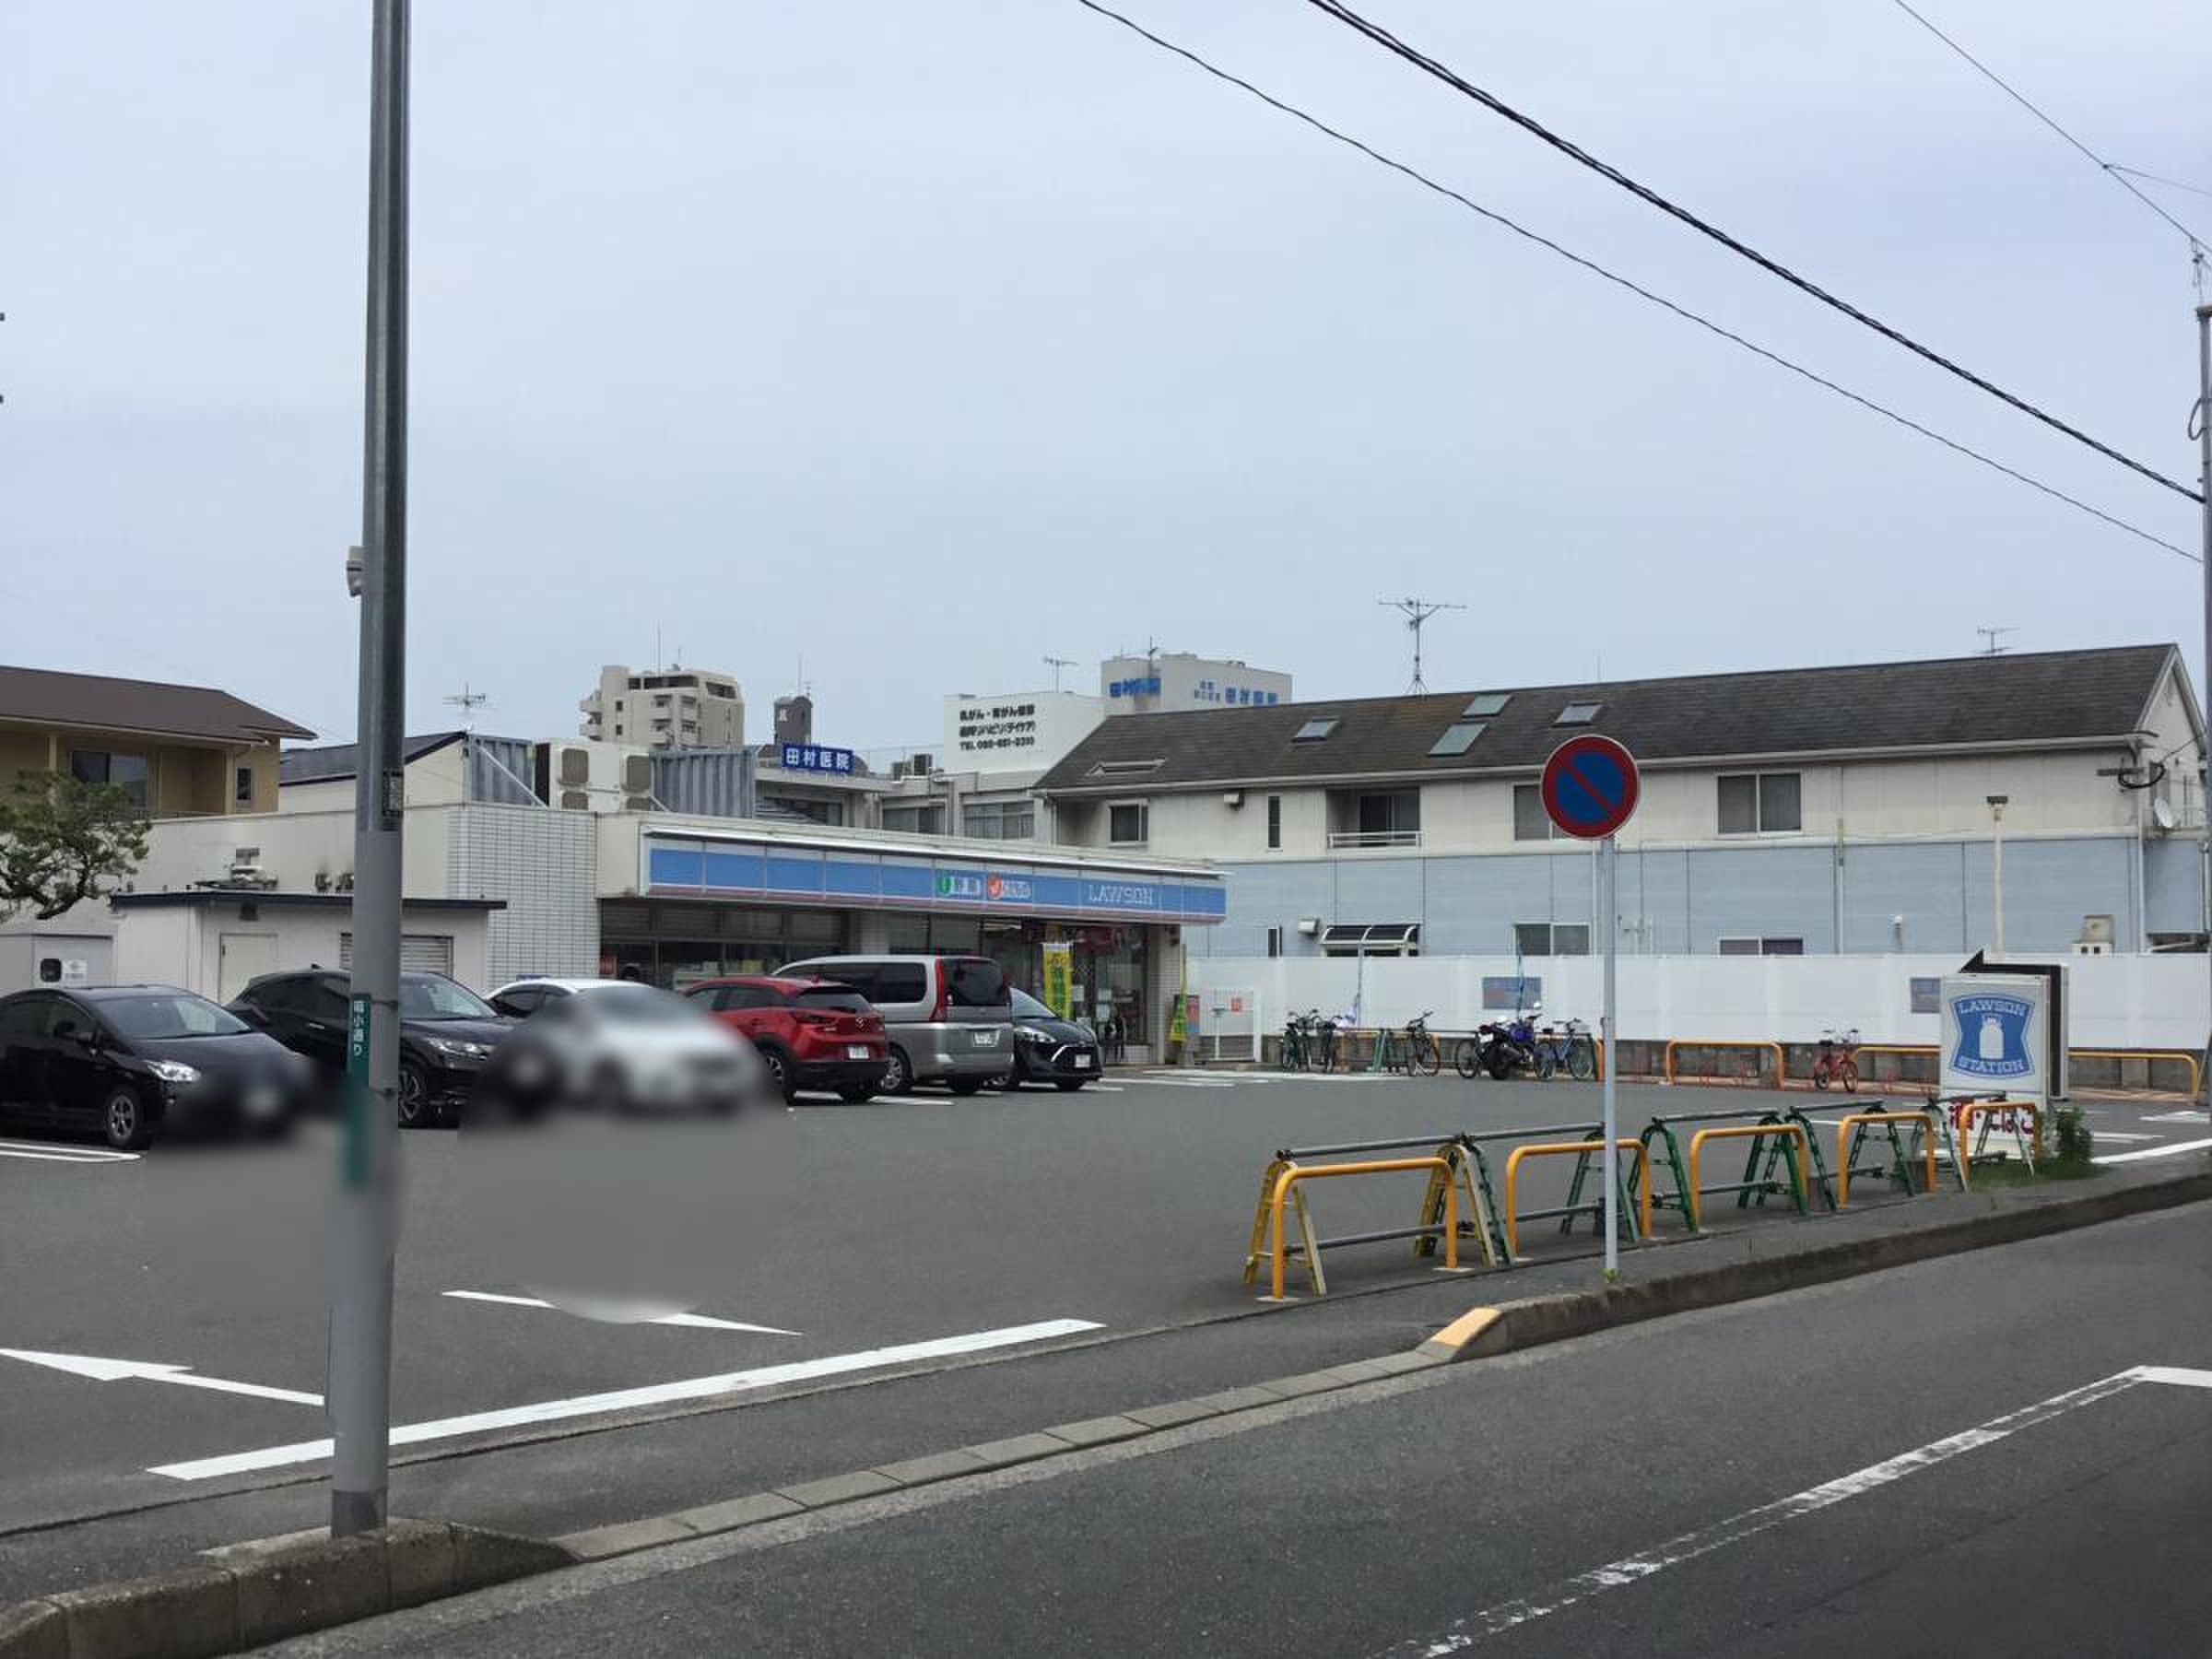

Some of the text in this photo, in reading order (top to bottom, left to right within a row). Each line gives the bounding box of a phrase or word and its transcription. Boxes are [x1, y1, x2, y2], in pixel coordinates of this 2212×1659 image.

[786, 747, 850, 770] 田村医院
[1088, 883, 1153, 906] LAWSON
[1959, 1000, 2026, 1017] LAWSON
[1959, 1057, 2024, 1074] STATION
